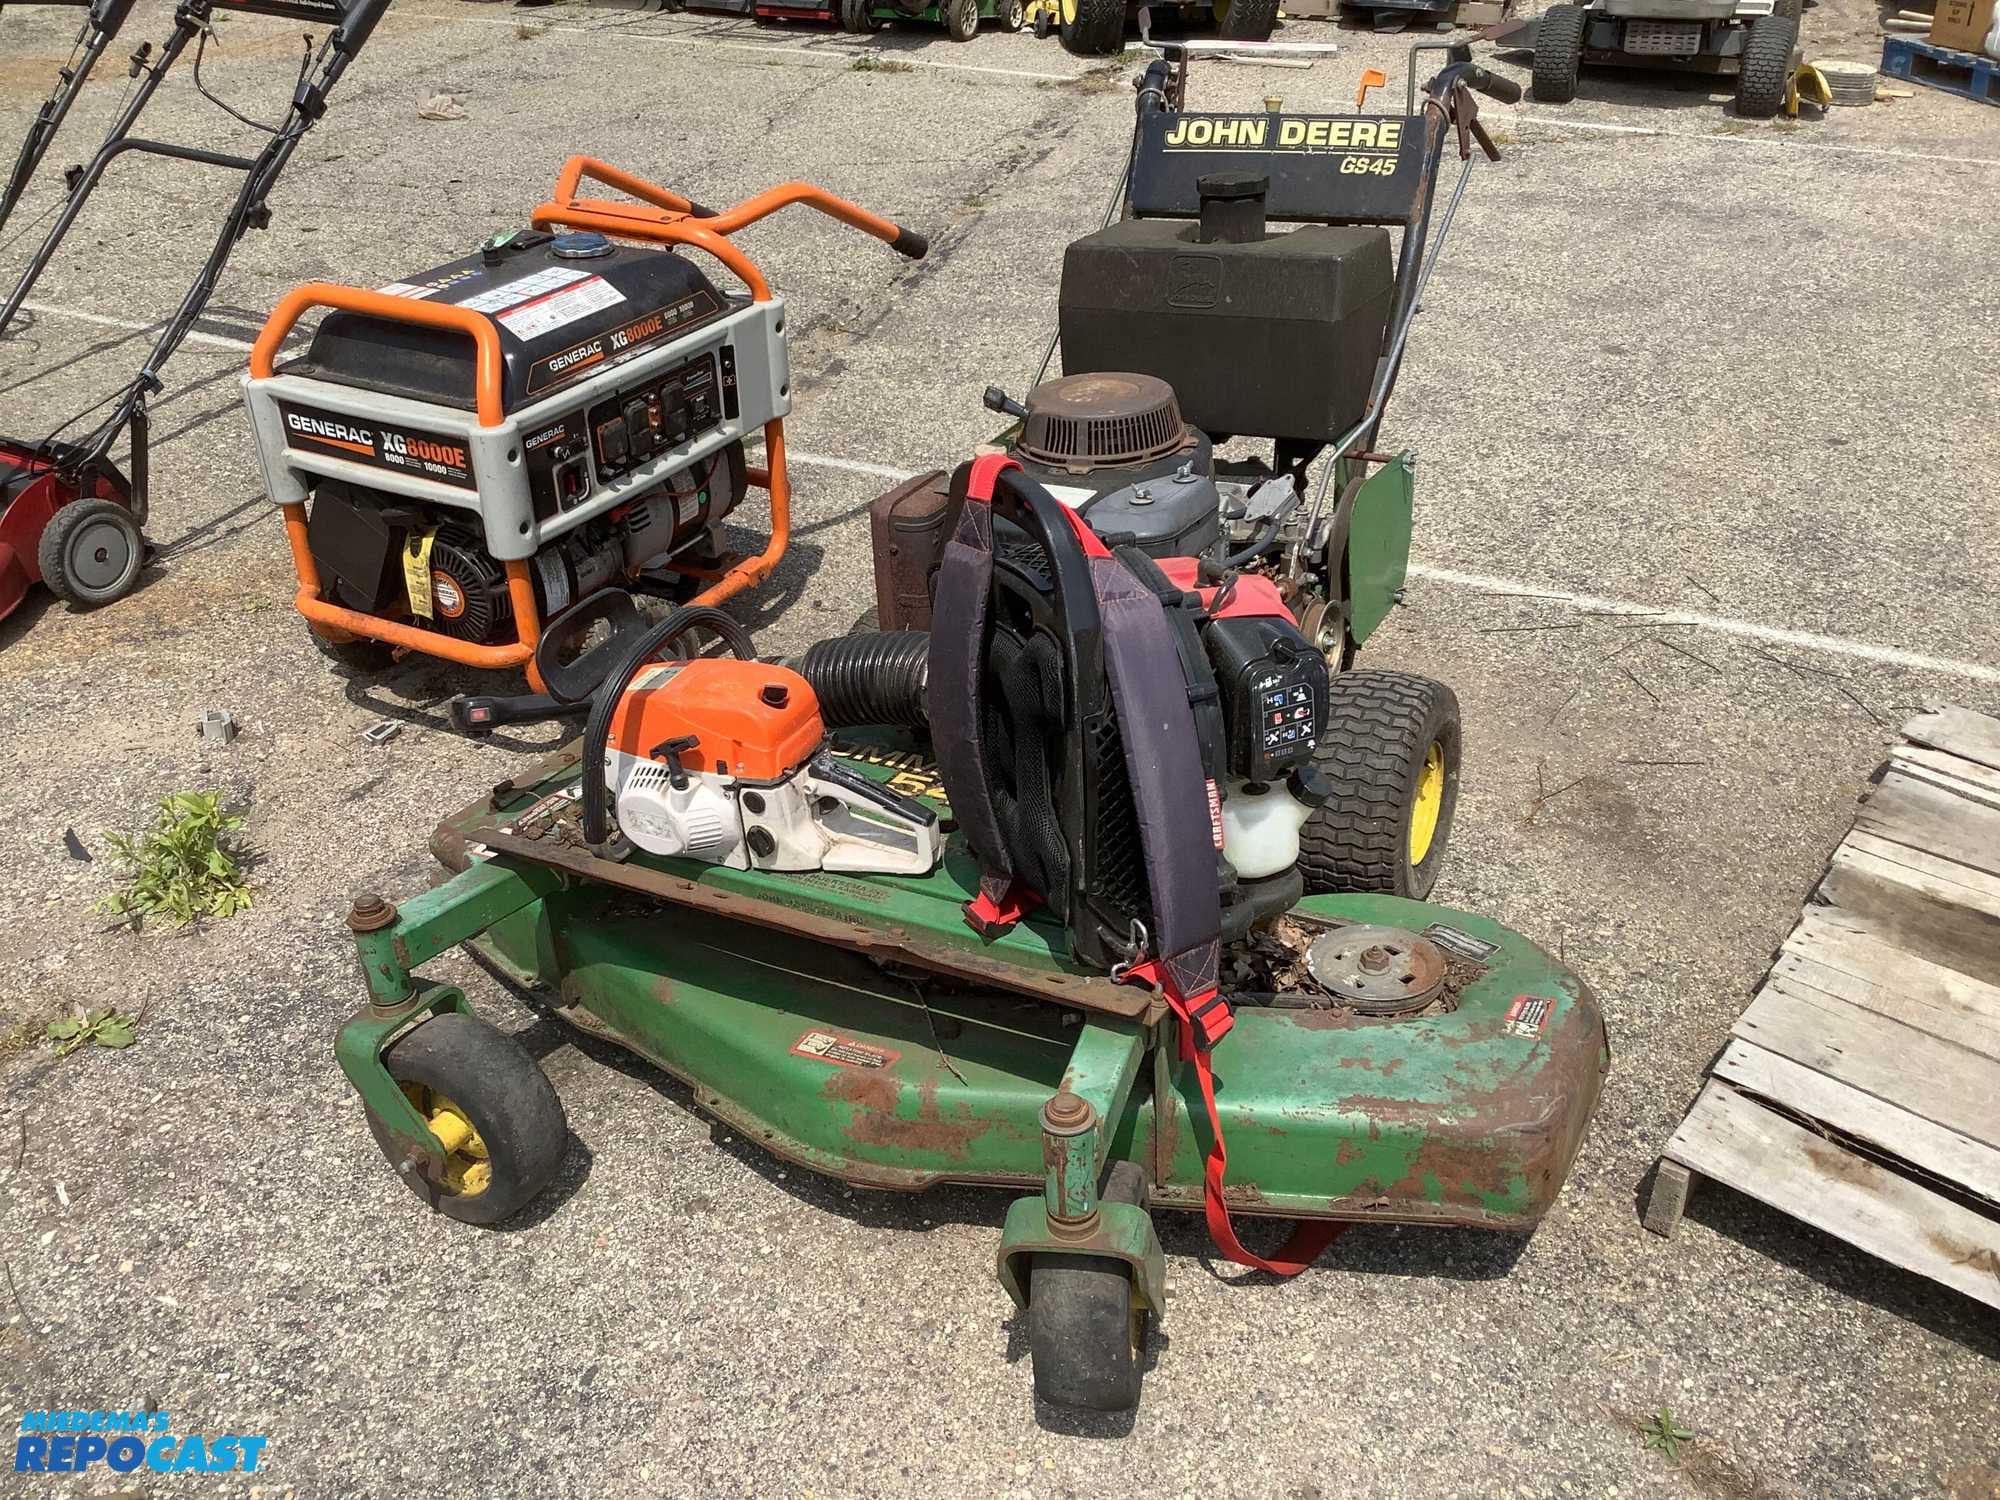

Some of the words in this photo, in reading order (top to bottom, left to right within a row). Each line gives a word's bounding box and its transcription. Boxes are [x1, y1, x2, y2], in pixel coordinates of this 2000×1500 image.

[1166, 119, 1267, 146] JOHN
[1279, 120, 1402, 148] DEERE
[1339, 156, 1397, 176] GS45
[549, 341, 602, 372] GENERAC
[610, 316, 663, 350] XG8000E
[288, 413, 373, 446] GENERAC
[380, 430, 466, 468] XG8000E
[526, 424, 564, 448] GENERAC
[384, 452, 405, 465] 8000
[423, 461, 447, 475] 10000
[1205, 782, 1223, 848] CRAFTSMAN
